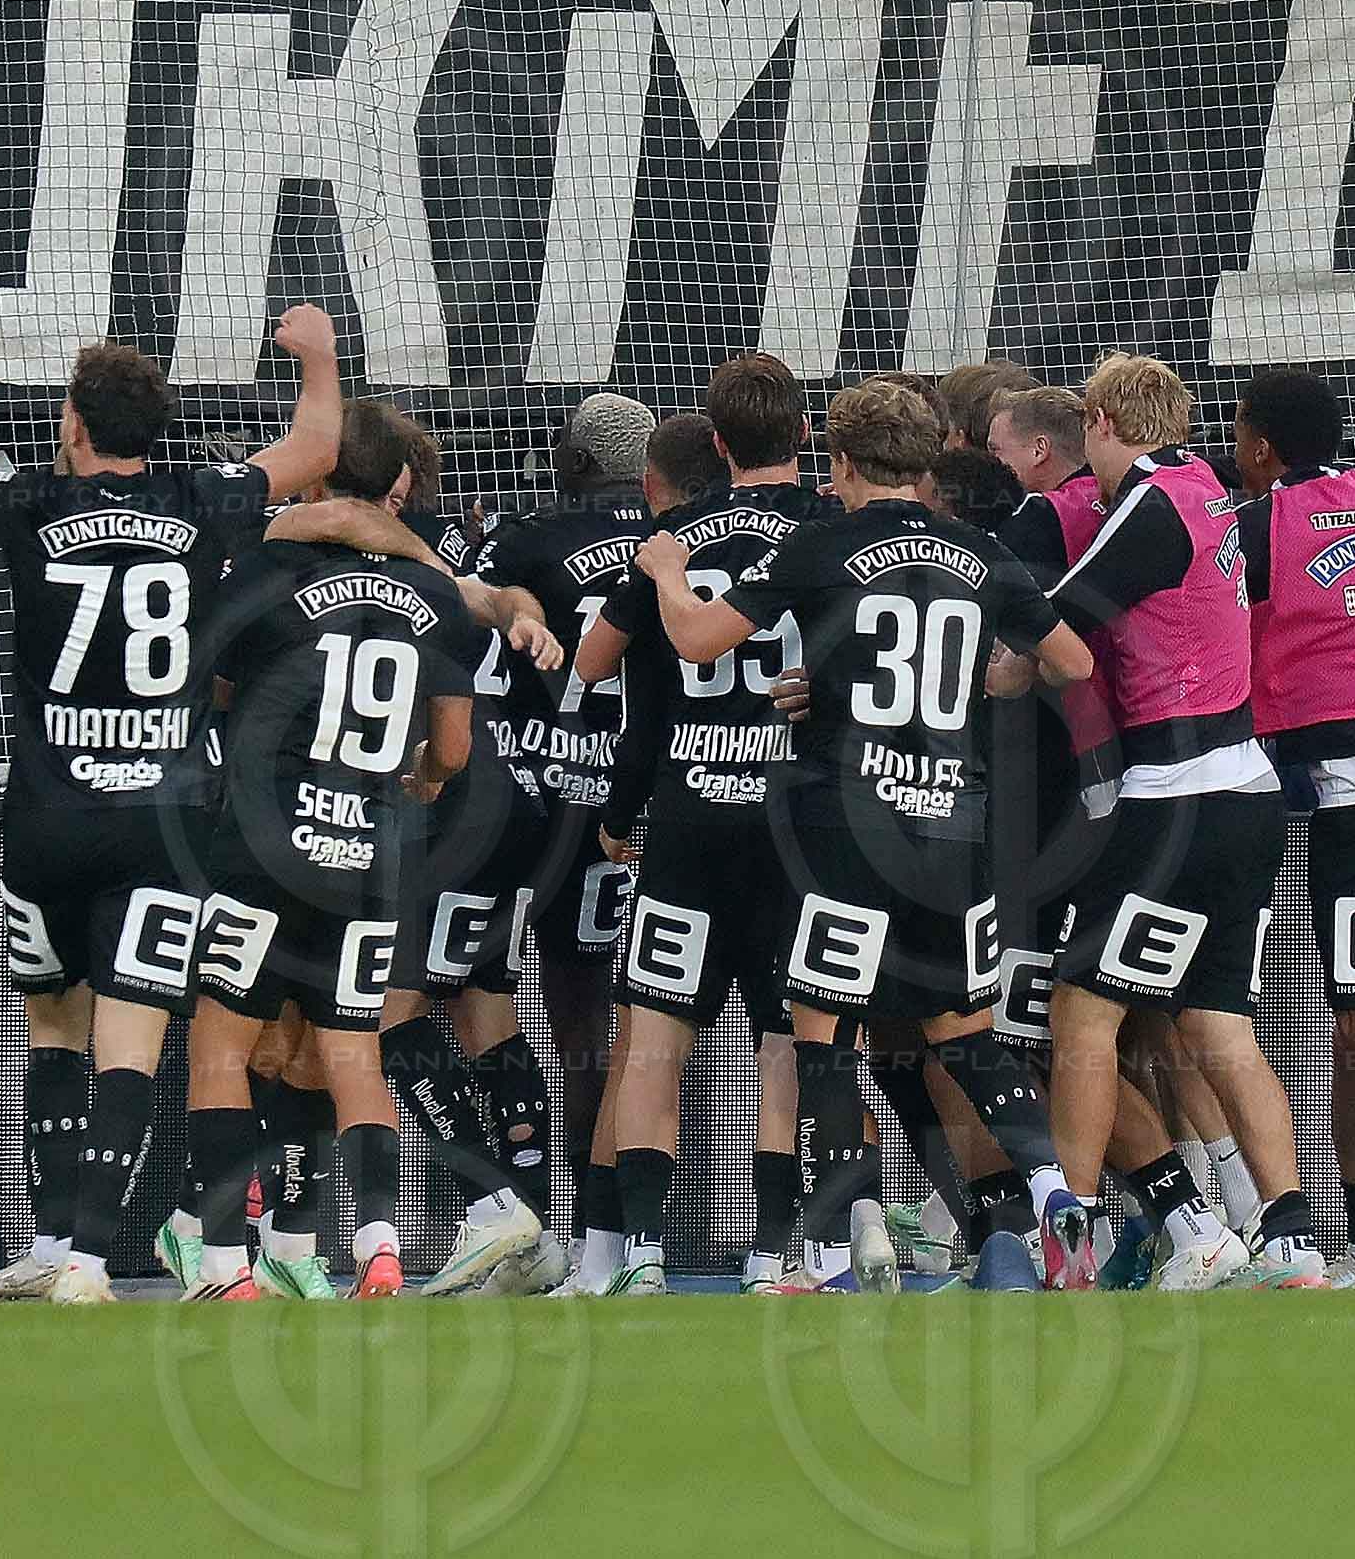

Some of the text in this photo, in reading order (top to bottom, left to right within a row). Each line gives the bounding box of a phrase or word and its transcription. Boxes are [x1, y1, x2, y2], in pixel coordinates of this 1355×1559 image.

[46, 514, 189, 550] PUNTIGAMER
[855, 540, 981, 583] PUNTIGAMER
[44, 561, 191, 697] 78
[309, 577, 433, 630] PUNTIGAMER
[850, 593, 983, 731] 30
[44, 703, 191, 750] MATOSHI
[309, 632, 420, 774] 19
[670, 723, 798, 763] WEINHANDL
[797, 1117, 818, 1196] NovaLabs
